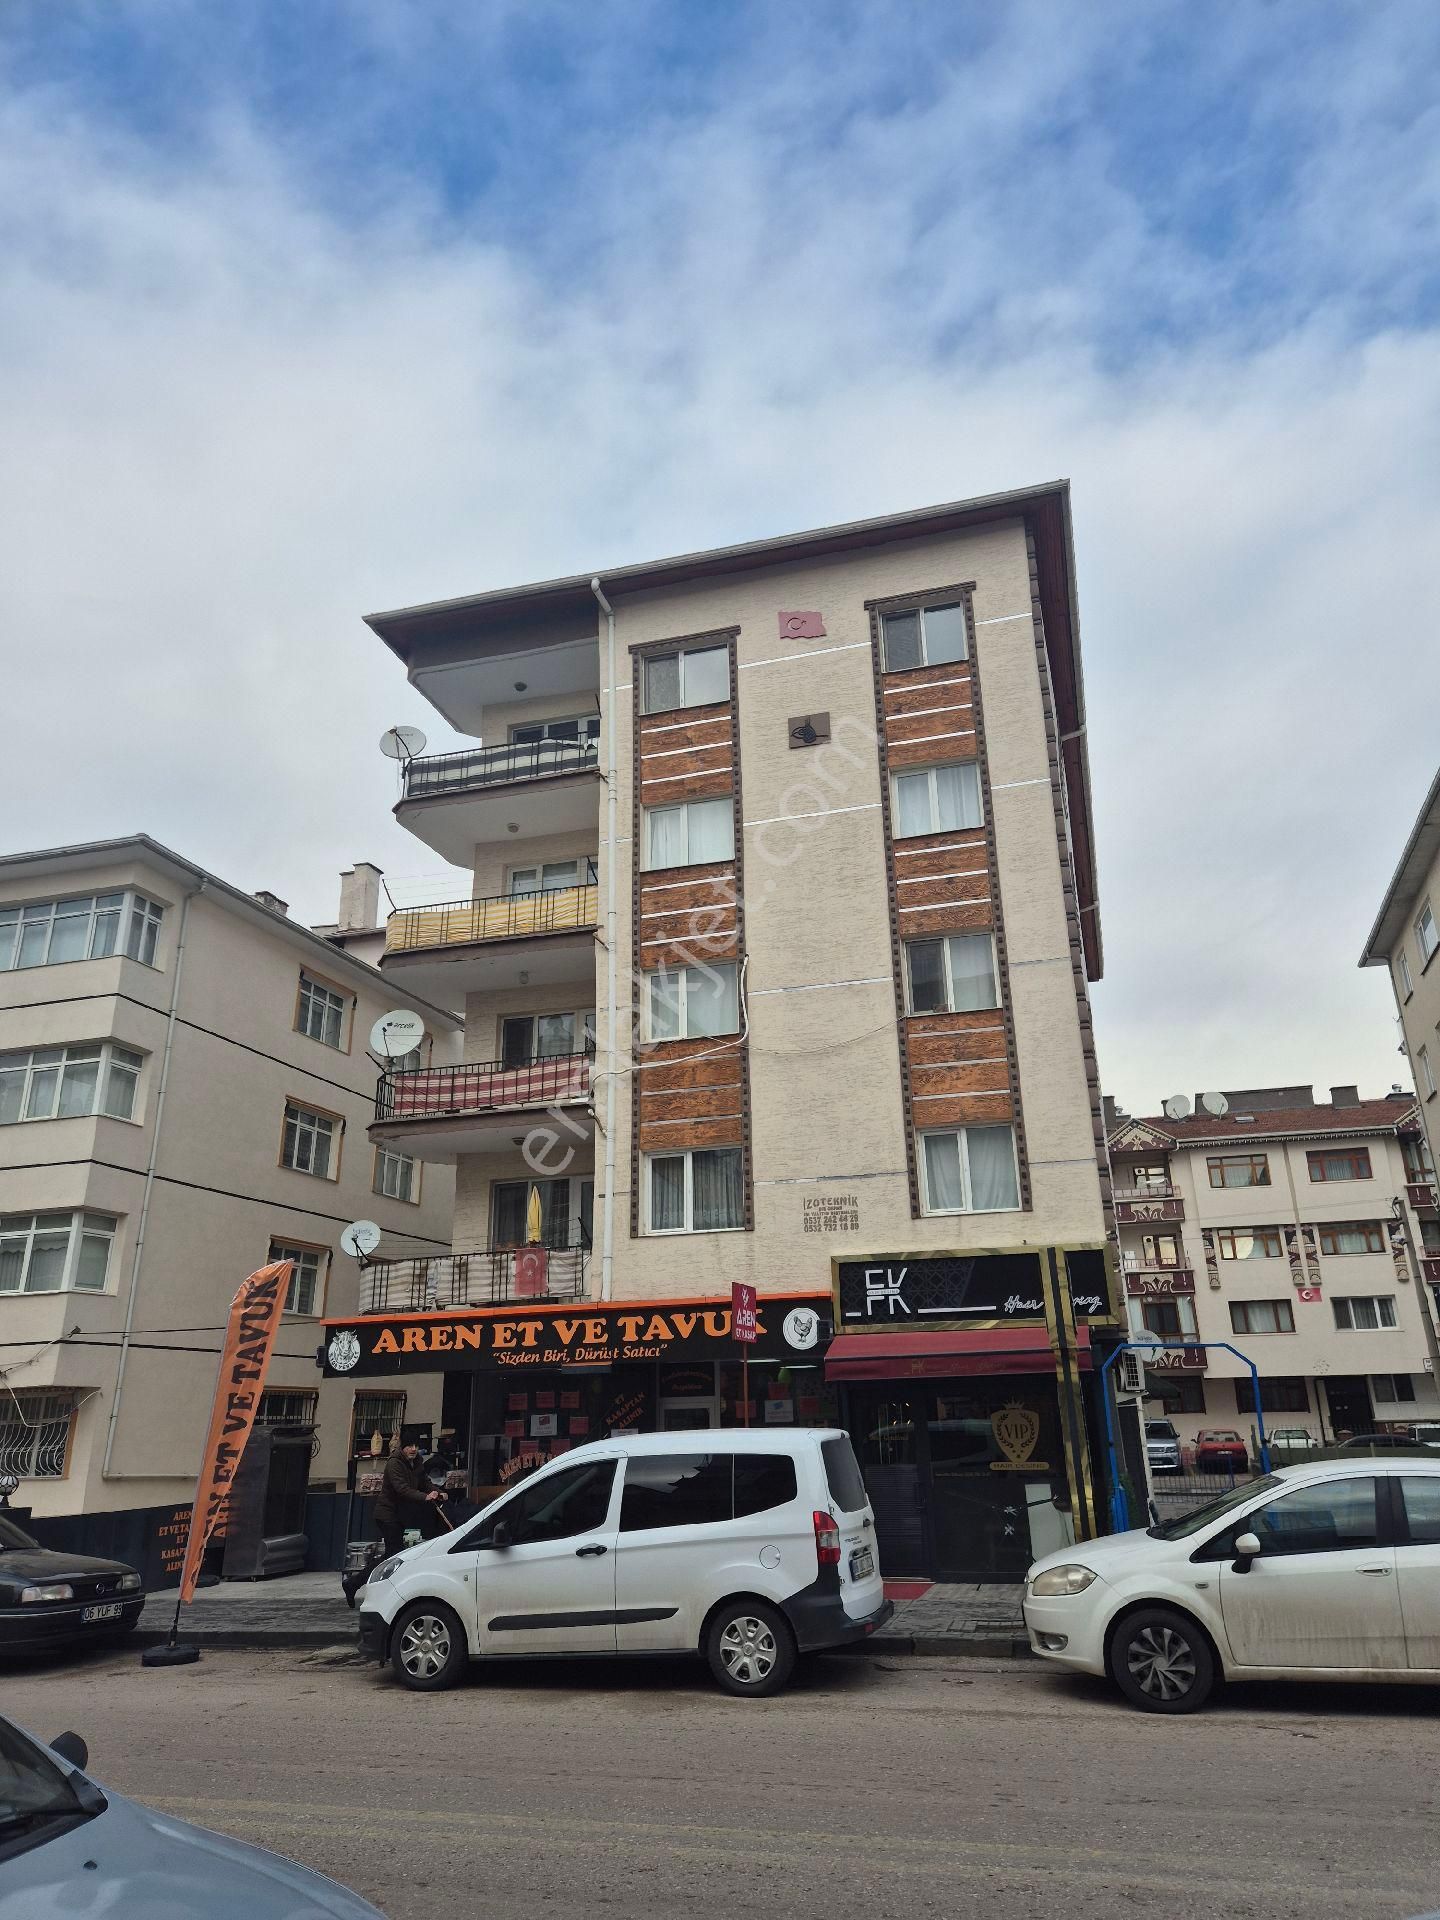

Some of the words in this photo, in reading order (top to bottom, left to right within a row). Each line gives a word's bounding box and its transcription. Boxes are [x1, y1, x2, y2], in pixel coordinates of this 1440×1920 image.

[231, 1276, 281, 1385] TAVUK
[736, 1308, 756, 1327] AREN
[371, 1324, 484, 1354] AREN
[492, 1320, 544, 1347] ET
[552, 1317, 609, 1345] VE
[222, 1391, 256, 1436] VE
[1003, 1423, 1030, 1440] VIP
[84, 1607, 95, 1619] 06
